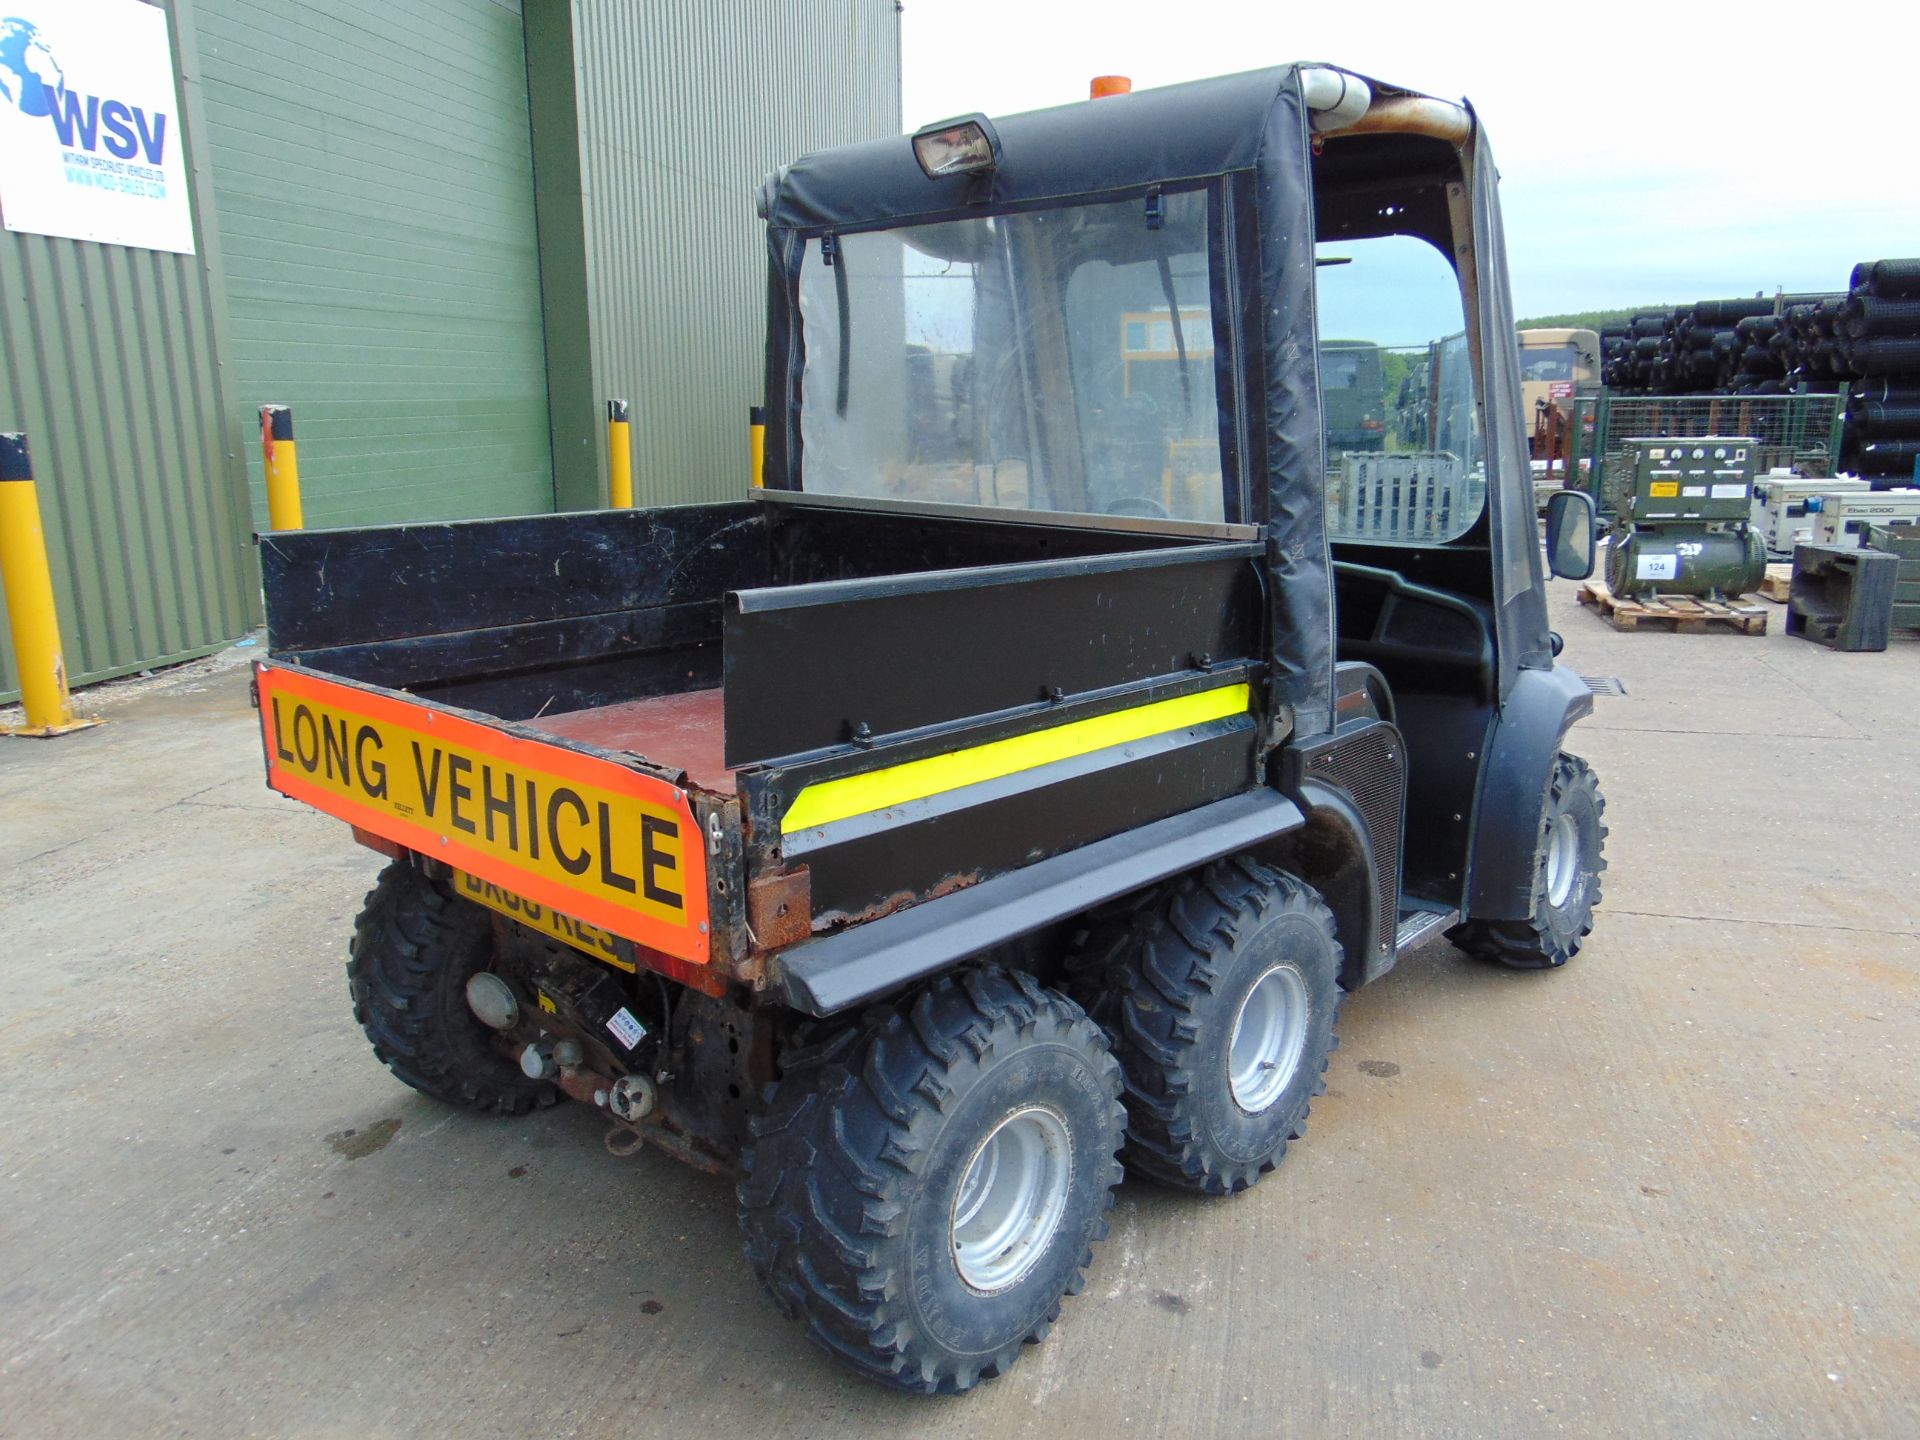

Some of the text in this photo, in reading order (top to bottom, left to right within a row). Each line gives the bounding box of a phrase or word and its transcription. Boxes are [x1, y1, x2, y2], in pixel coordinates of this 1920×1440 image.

[40, 83, 167, 166] WSV
[272, 696, 684, 910] LONG VEHICLE
